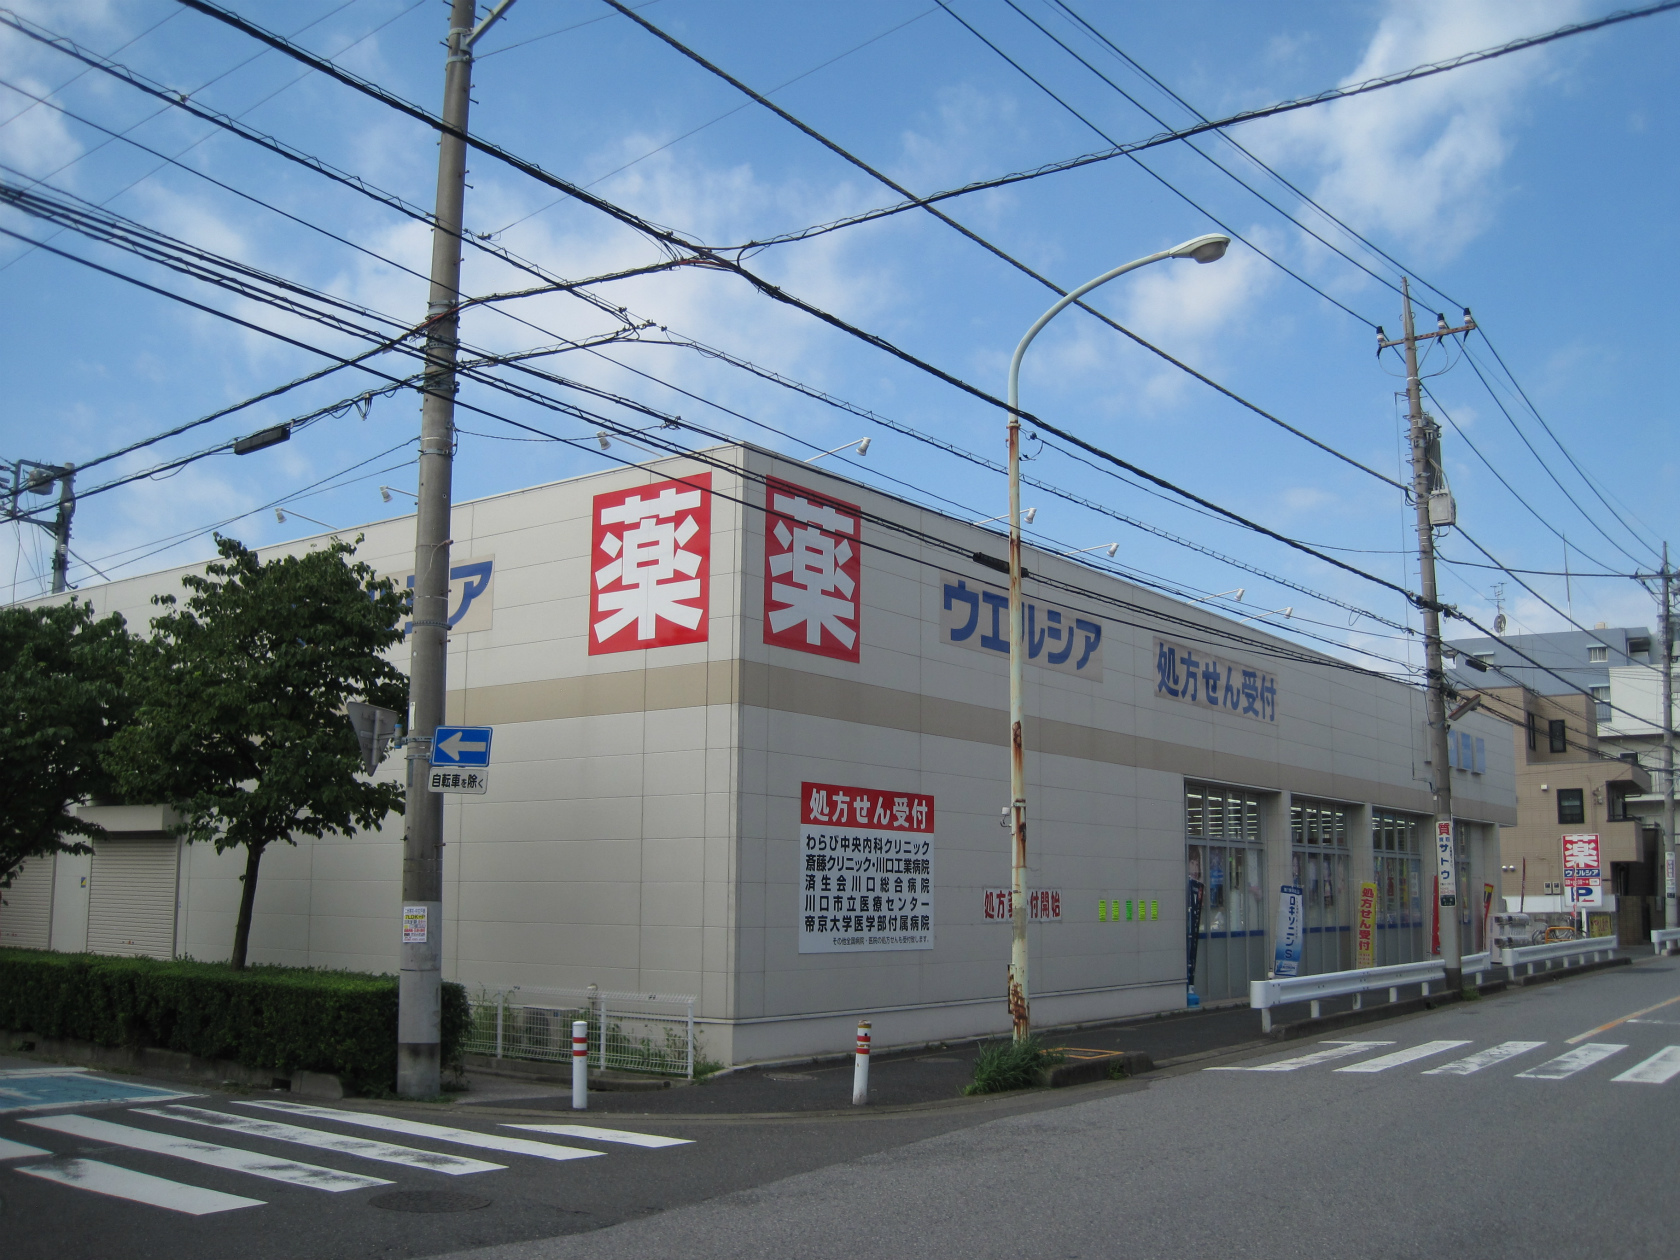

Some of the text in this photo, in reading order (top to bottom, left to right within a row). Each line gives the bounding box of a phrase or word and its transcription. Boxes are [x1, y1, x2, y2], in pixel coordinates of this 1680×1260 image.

[593, 488, 704, 643] 薬
[768, 493, 857, 650] 薬
[943, 580, 1102, 670] ウエルシア
[1156, 642, 1277, 722] 処方せん受付
[432, 773, 484, 789] 自転車を除く
[809, 788, 928, 829] 処方せん受付
[806, 834, 930, 855] わらび中央内科クリニック
[1438, 823, 1451, 836] 質
[1439, 844, 1450, 879] サトウ
[1564, 834, 1599, 868] 薬
[805, 874, 930, 894] 済生会川口総合病院
[804, 894, 930, 913] 川口市立医療センター
[984, 889, 1061, 920] 処方付開始
[1358, 887, 1375, 951] 処方せん受付
[804, 914, 930, 933] 帝京大学医学部付属病院
[1285, 896, 1296, 959] ロキソニンS
